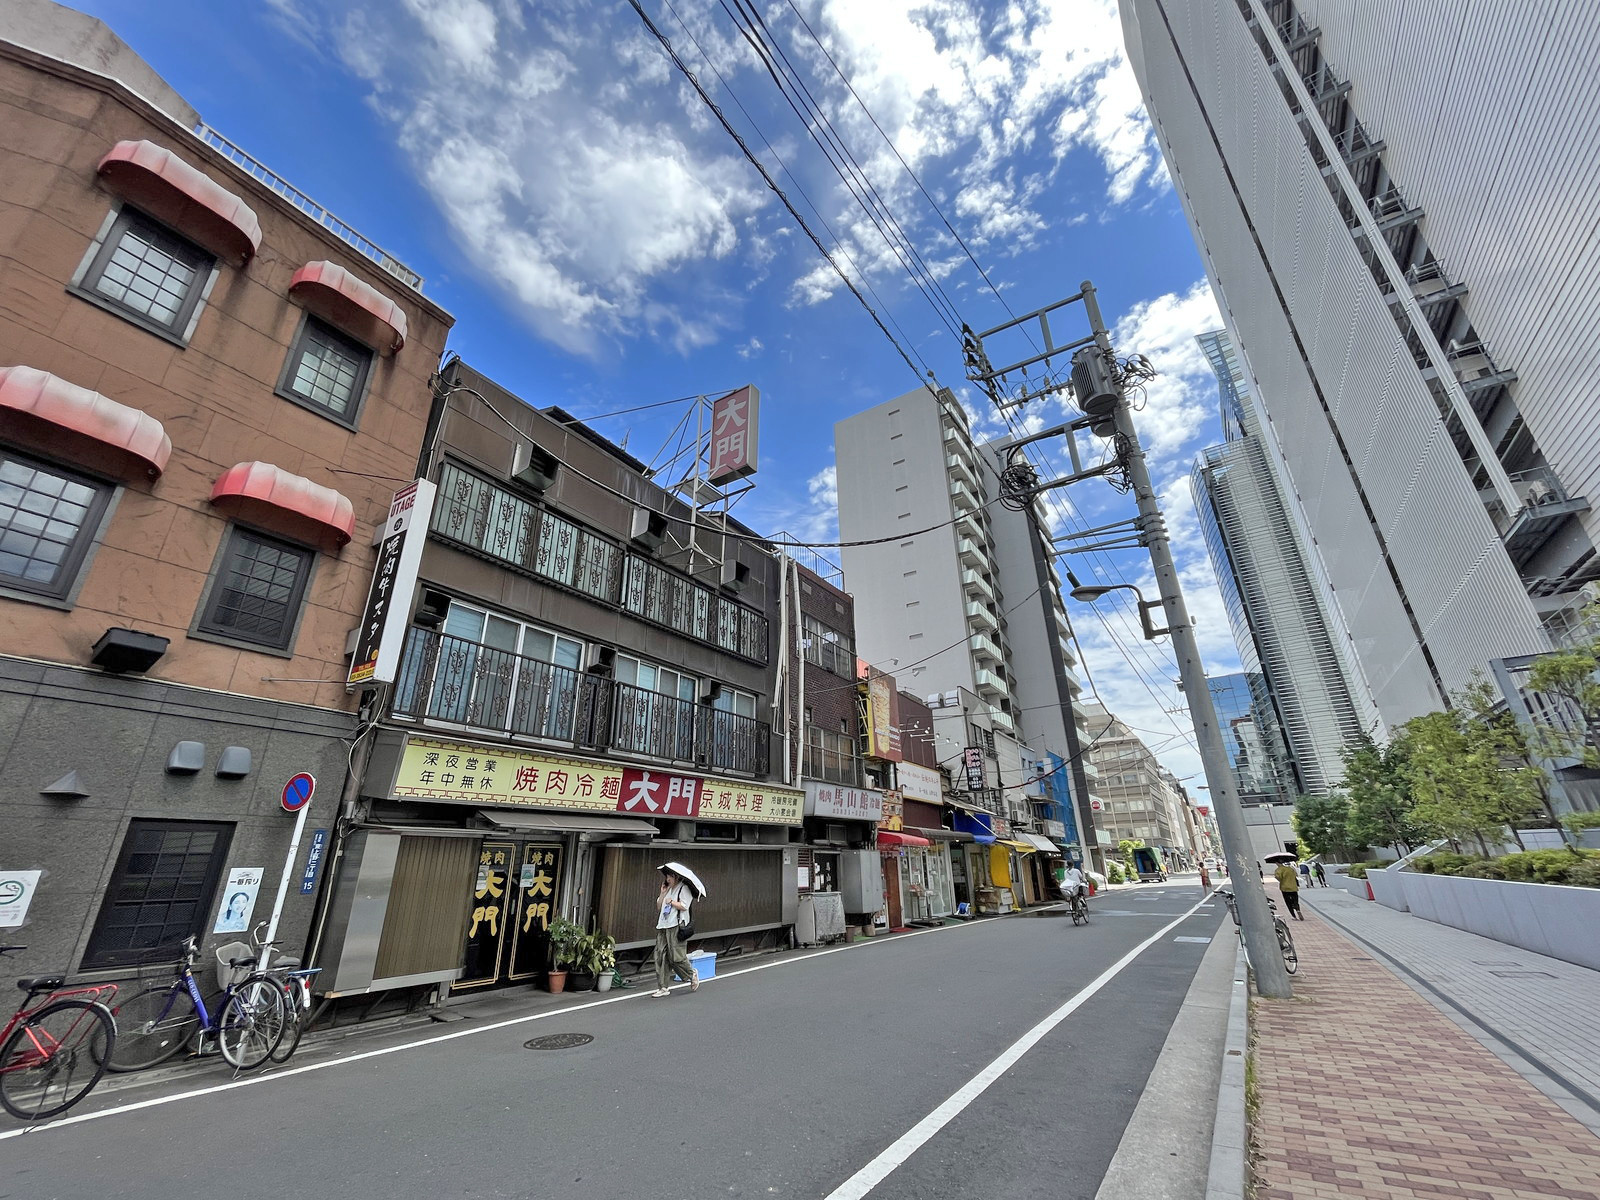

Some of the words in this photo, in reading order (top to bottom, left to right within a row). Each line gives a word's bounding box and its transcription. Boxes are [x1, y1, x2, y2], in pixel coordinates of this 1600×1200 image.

[714, 398, 747, 469] 大門
[390, 494, 417, 518] UTAGE
[423, 752, 498, 773] 深夜営業
[419, 770, 493, 790] 年中無休
[624, 771, 697, 815] 大門
[700, 788, 764, 813] 京城料理
[833, 787, 869, 810] 馬山館
[480, 850, 505, 866] 焼肉
[531, 851, 554, 866] 焼肉
[303, 882, 313, 890] 15
[469, 869, 505, 939] 大門
[523, 869, 553, 933] 大門
